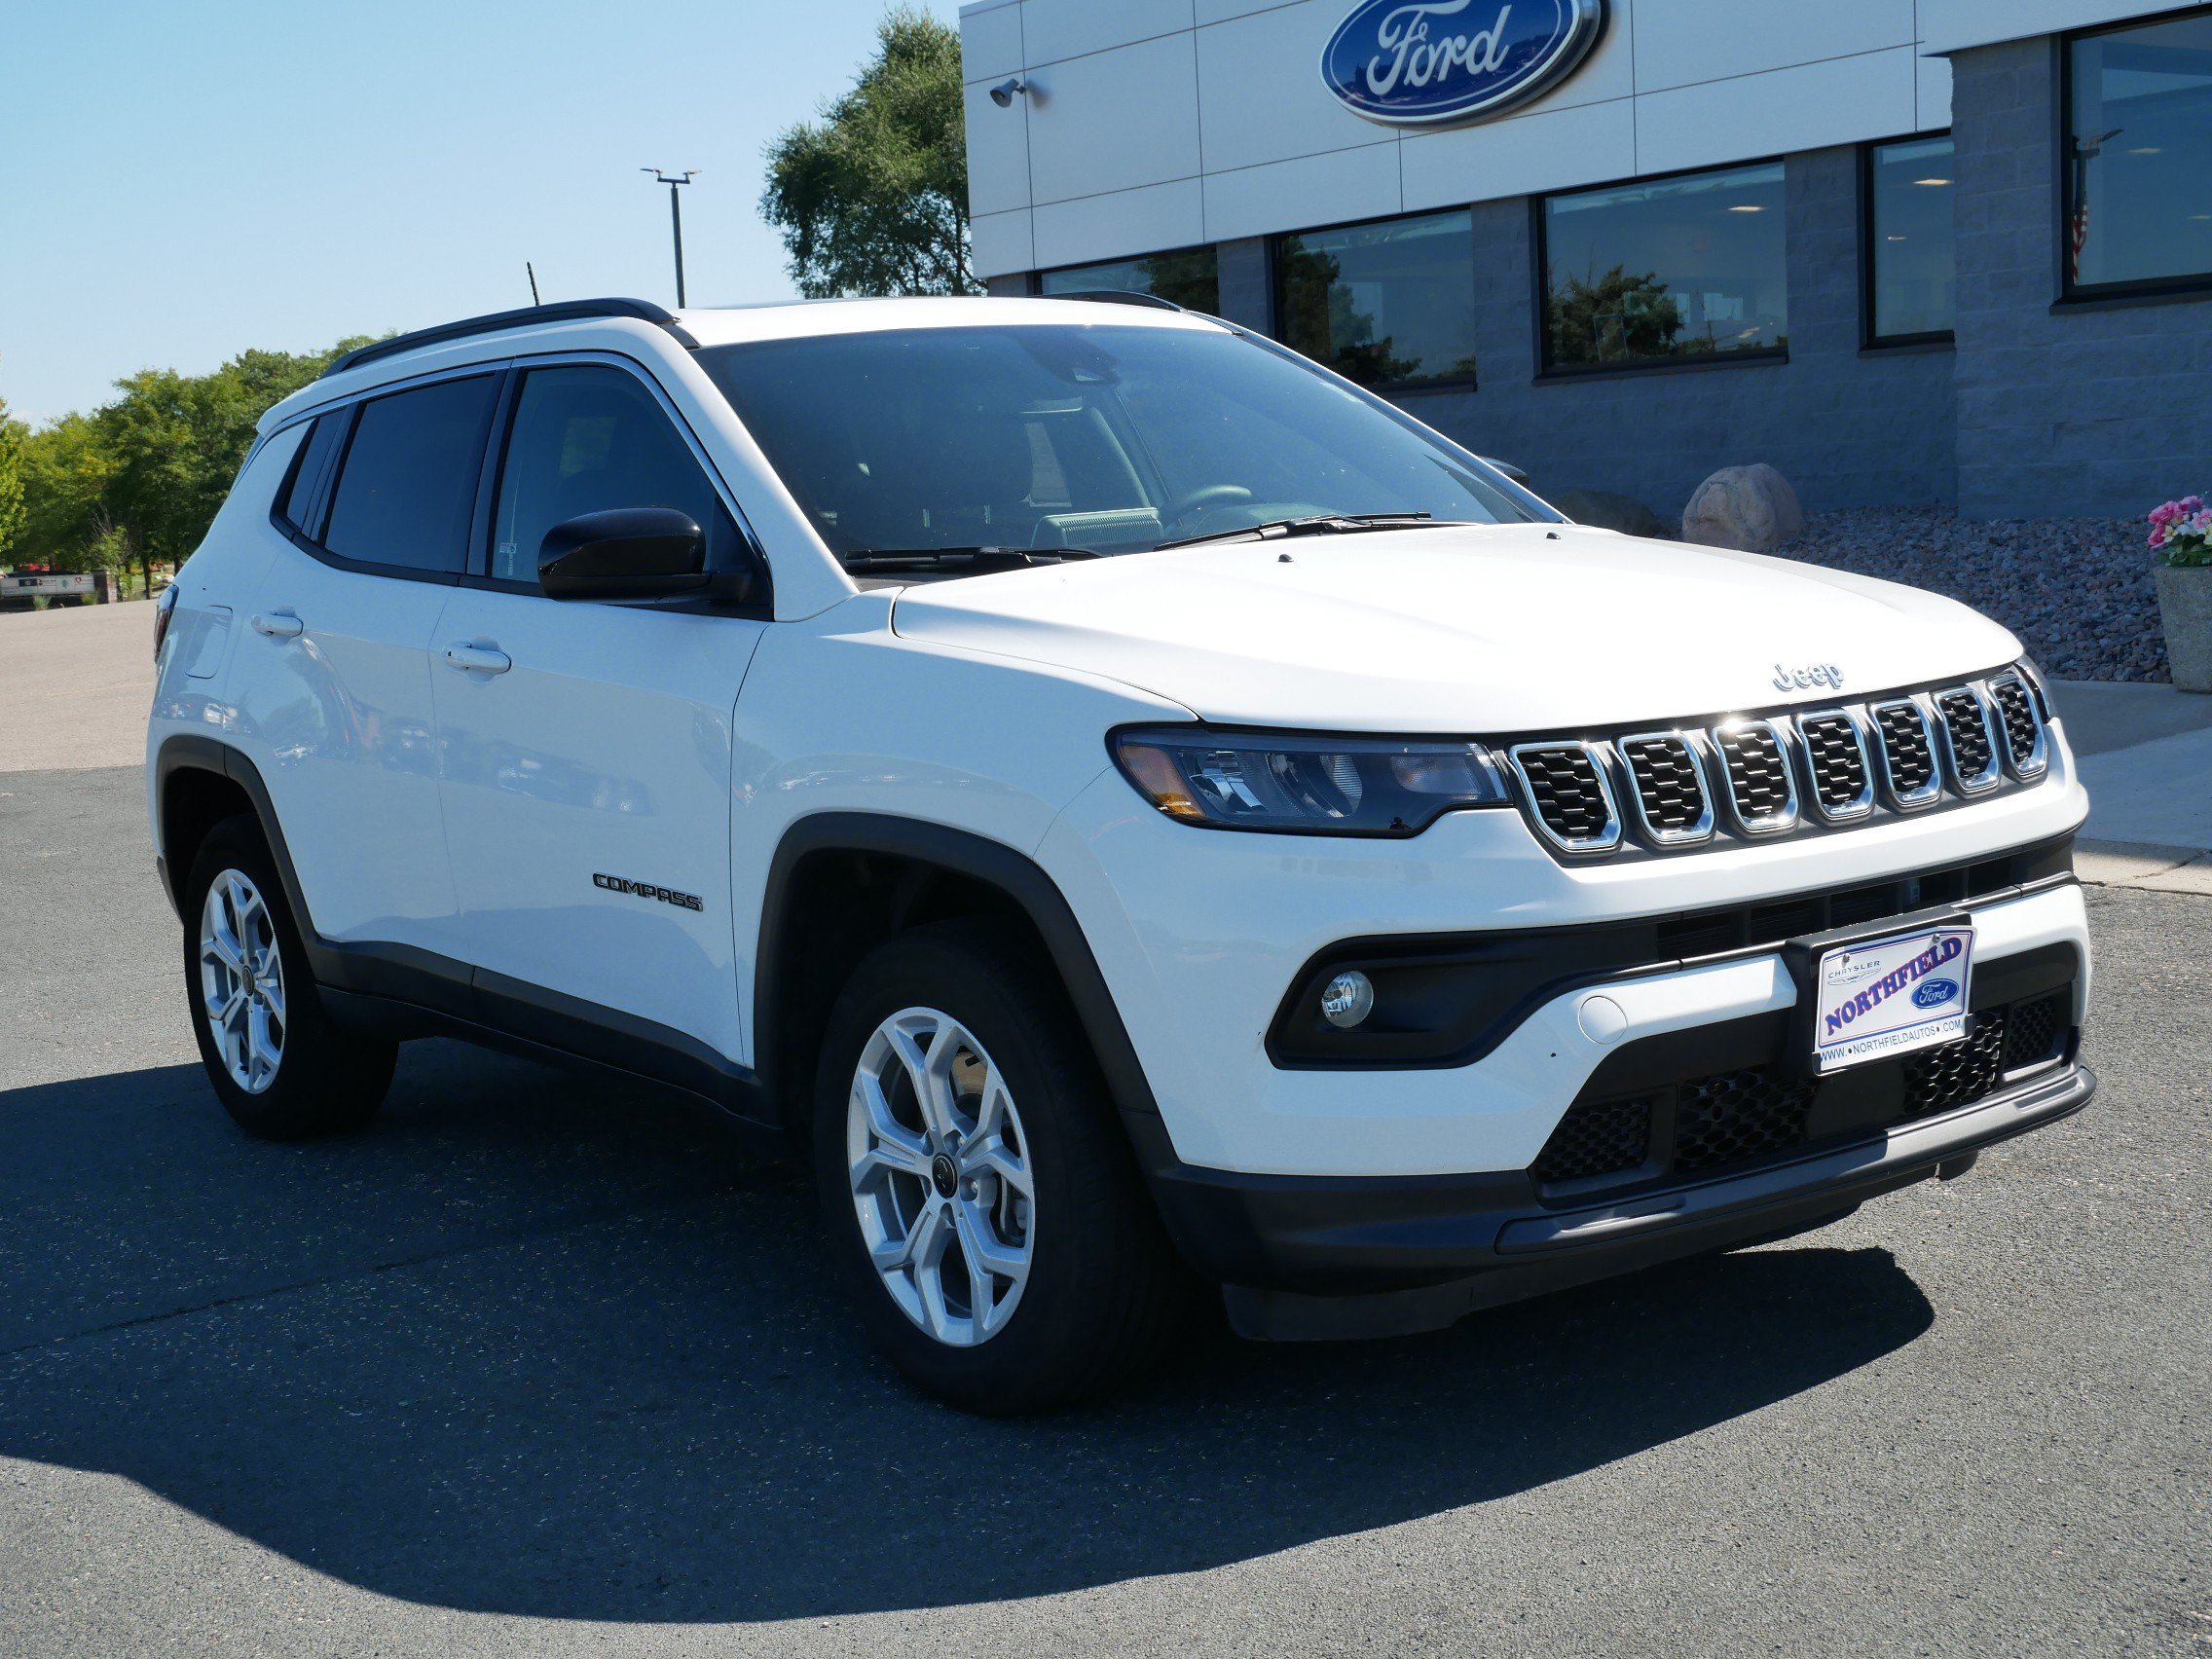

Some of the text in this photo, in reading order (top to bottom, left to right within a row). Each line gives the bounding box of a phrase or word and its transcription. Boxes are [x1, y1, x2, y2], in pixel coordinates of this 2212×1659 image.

[1366, 0, 1510, 95] Ford
[1772, 663, 1844, 692] Jeep
[592, 872, 704, 911] COMPASS
[1827, 960, 1881, 978] CHRYSLER
[1825, 937, 1963, 1037] NORTHFIELD
[1919, 983, 1948, 1005] Ford
